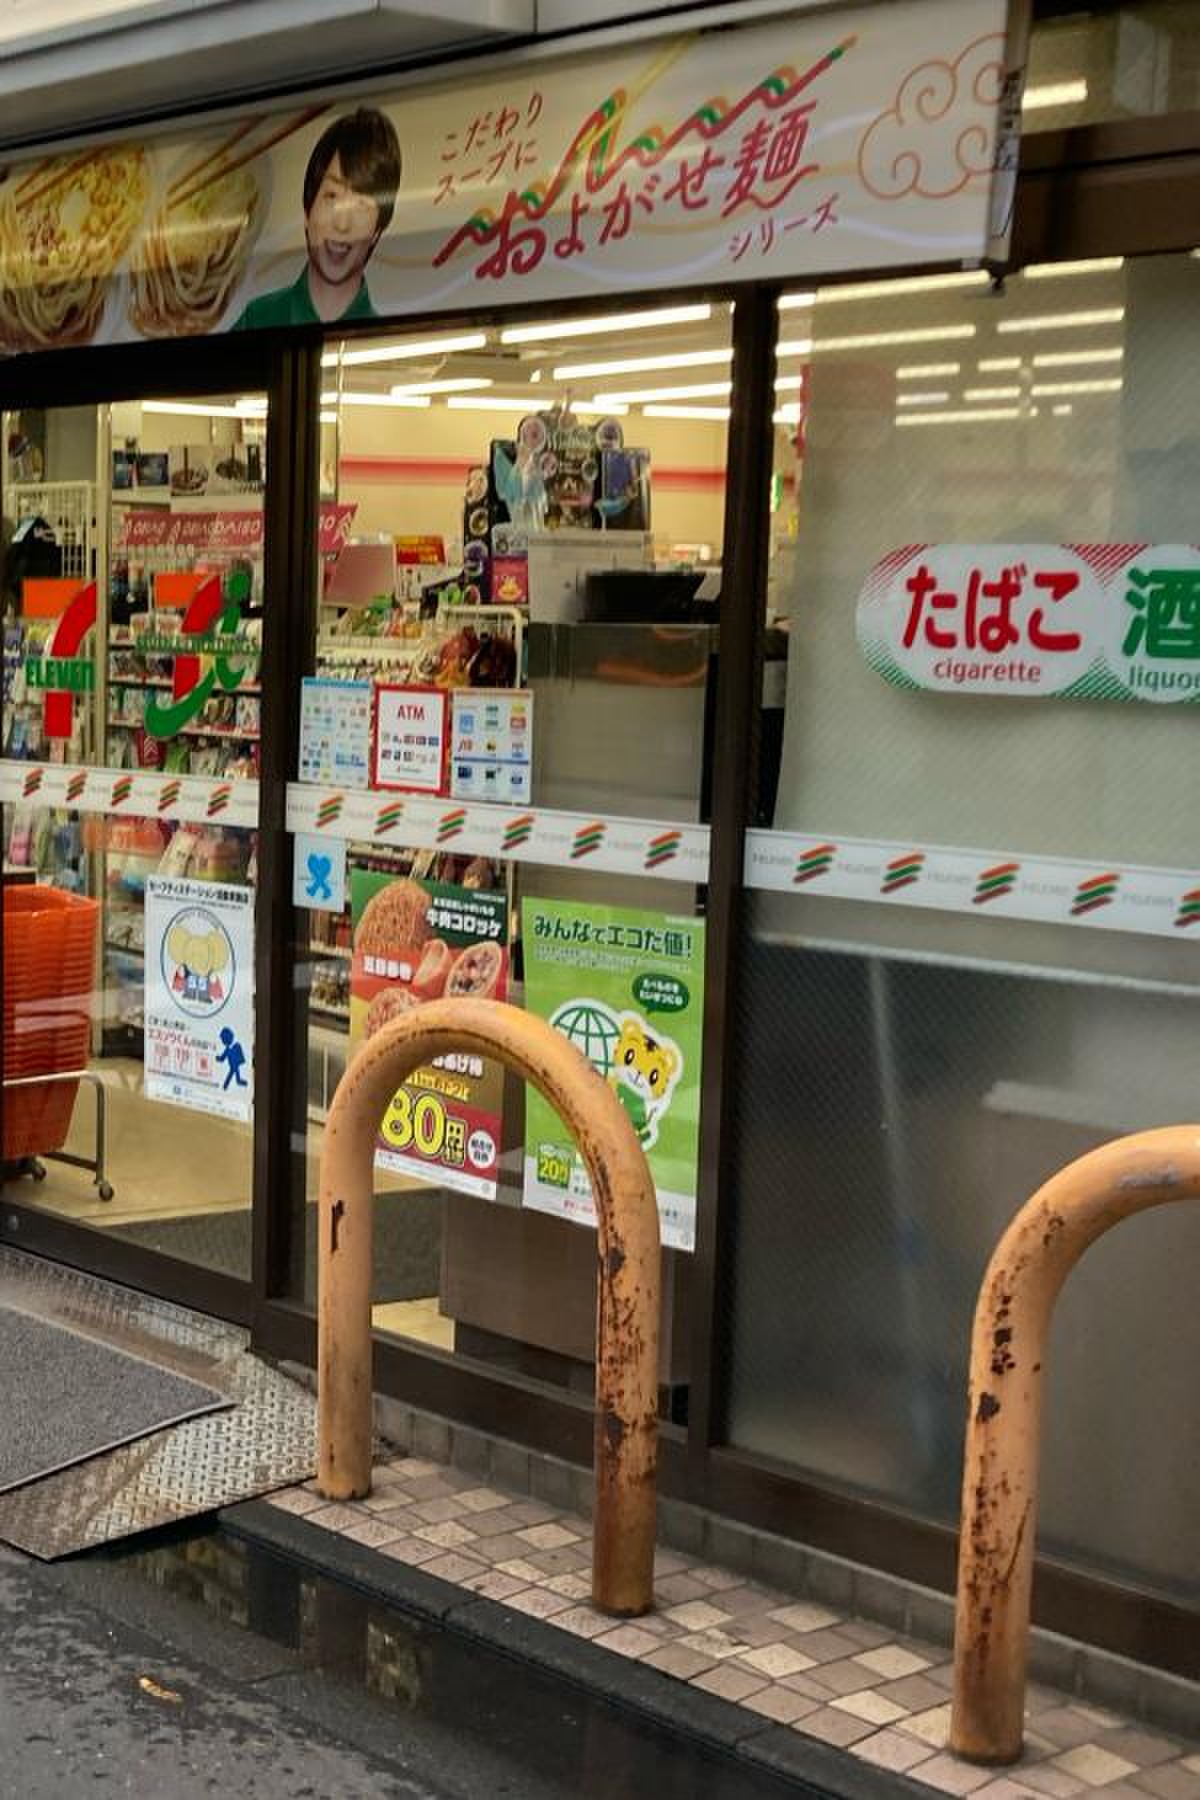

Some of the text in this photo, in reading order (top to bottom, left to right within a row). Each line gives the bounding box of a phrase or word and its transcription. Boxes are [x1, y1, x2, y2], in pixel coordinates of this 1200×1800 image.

[441, 91, 543, 162] こだわり
[433, 139, 538, 206] スープに
[728, 193, 839, 262] シリーズ
[902, 563, 1200, 659] たばこ 酒
[933, 657, 1041, 684] cigarette
[397, 704, 426, 721] ATM
